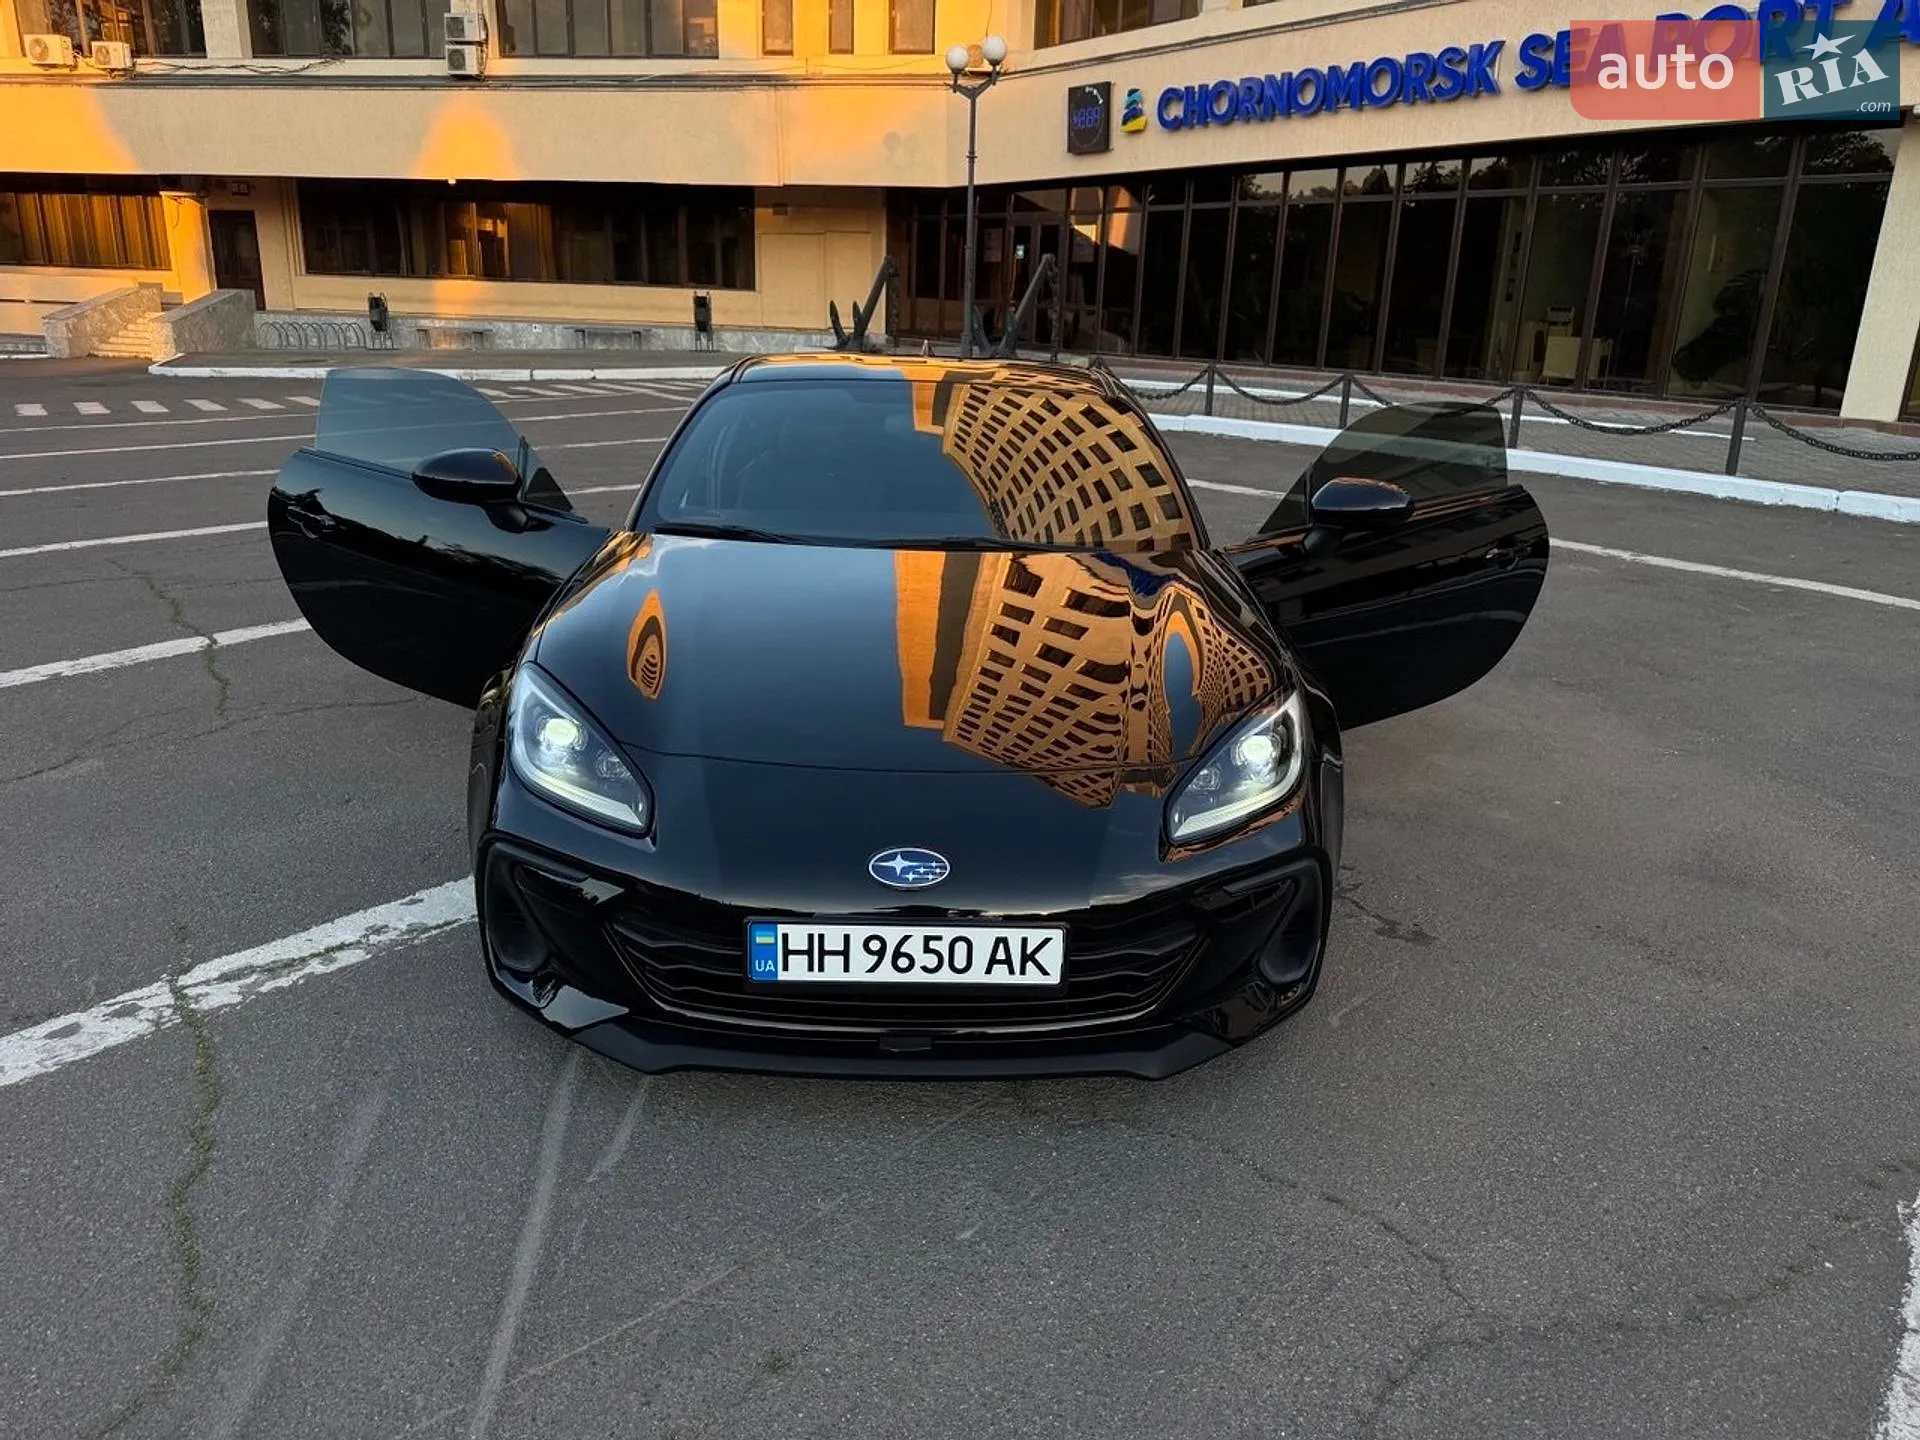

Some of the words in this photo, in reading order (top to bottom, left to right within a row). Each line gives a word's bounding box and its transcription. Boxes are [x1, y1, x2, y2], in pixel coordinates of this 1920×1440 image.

[1157, 41, 1505, 131] CHORNOMORSK
[1515, 23, 1629, 90] SEA
[1649, 0, 1853, 74] PORT
[755, 960, 775, 972] UA
[782, 933, 850, 973] HH
[863, 934, 973, 975] 9650
[984, 936, 1053, 976] AK
